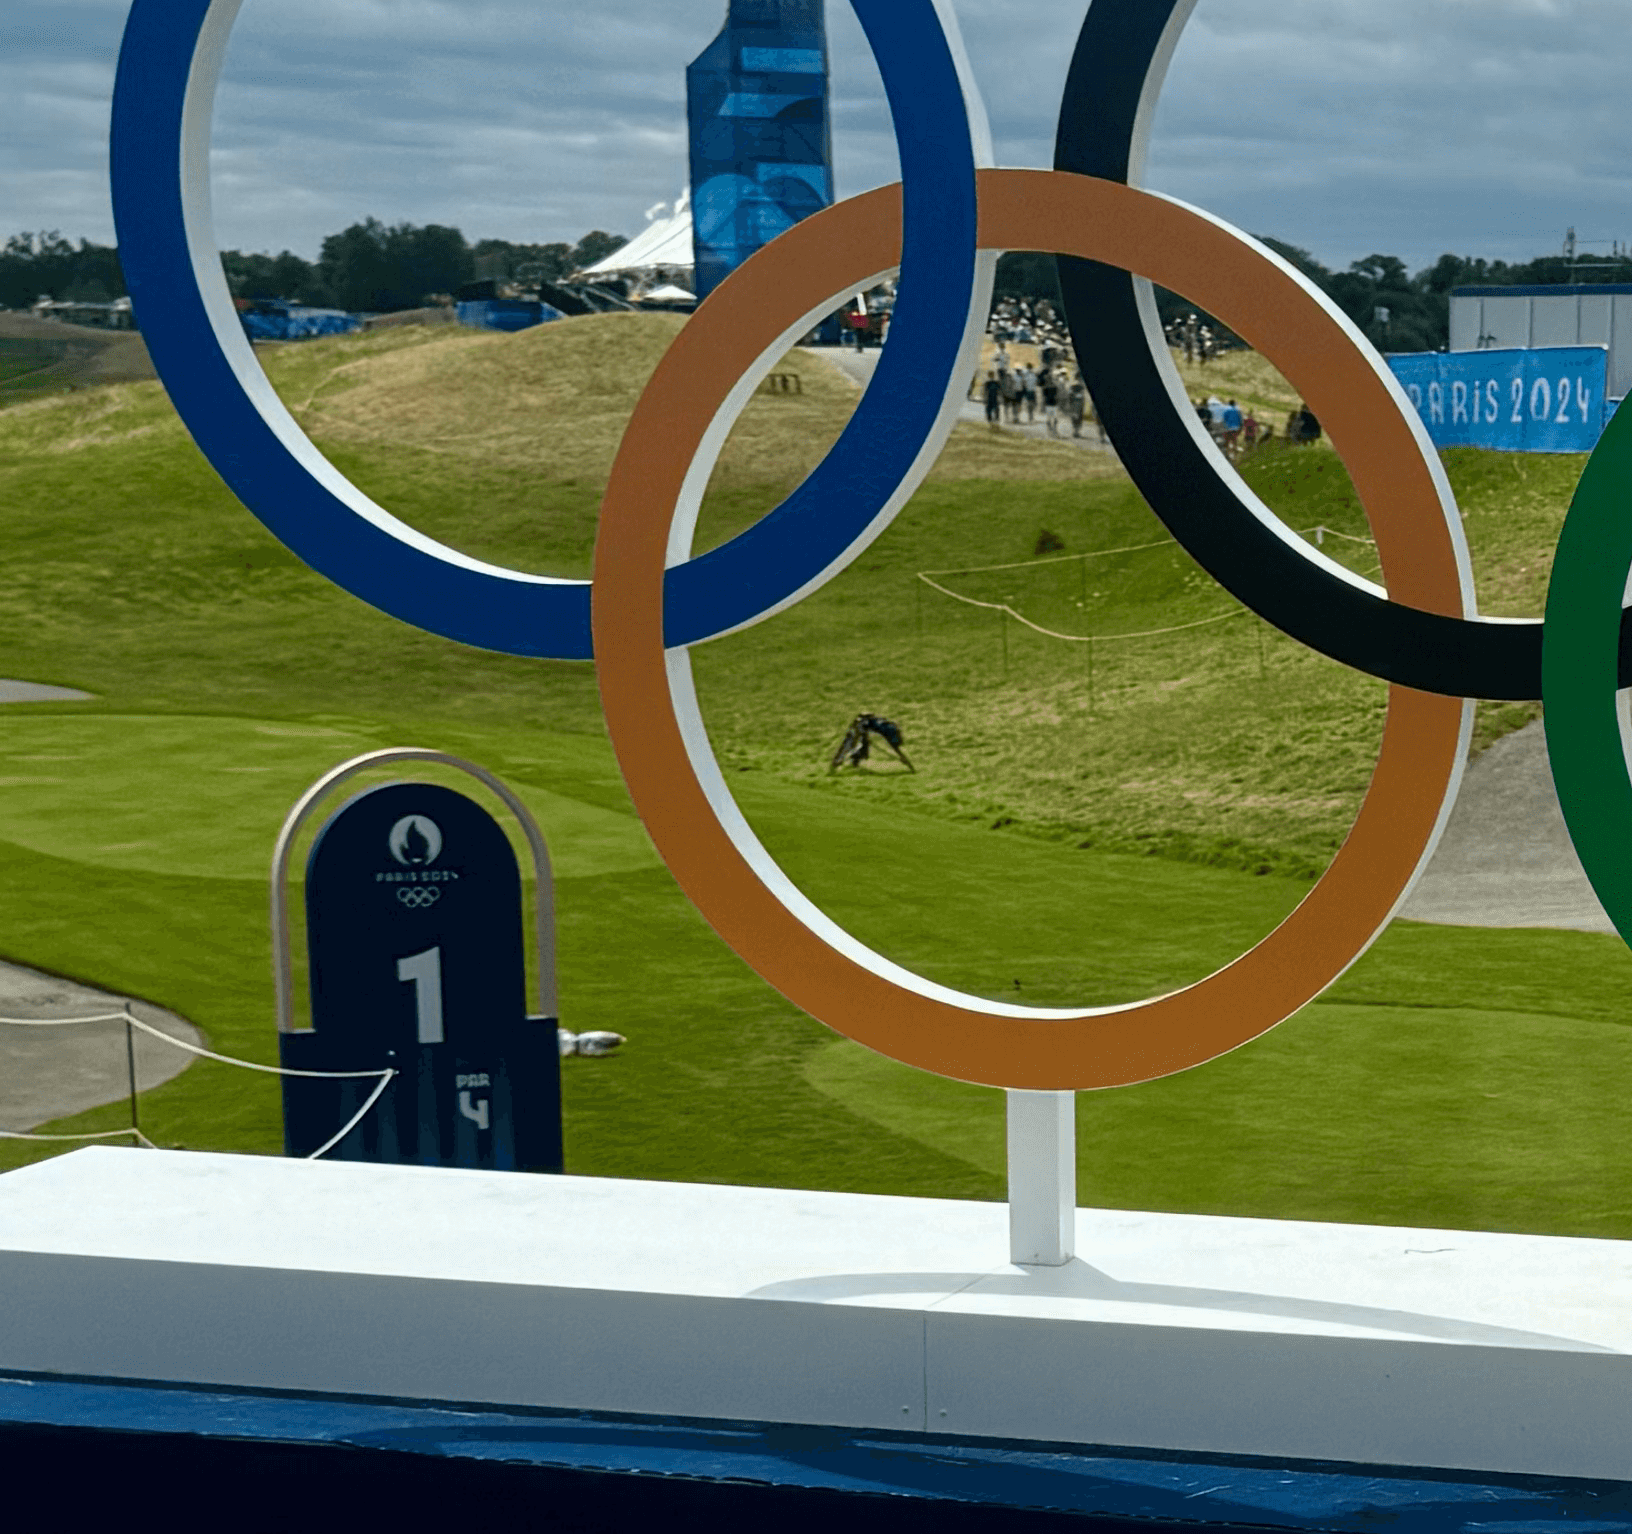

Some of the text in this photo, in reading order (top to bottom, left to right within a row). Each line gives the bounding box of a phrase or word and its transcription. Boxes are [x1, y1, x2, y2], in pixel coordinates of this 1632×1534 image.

[1510, 375, 1591, 425] 2024
[396, 945, 445, 1044] 1
[455, 1073, 491, 1089] PAR
[458, 1090, 490, 1131] 4
